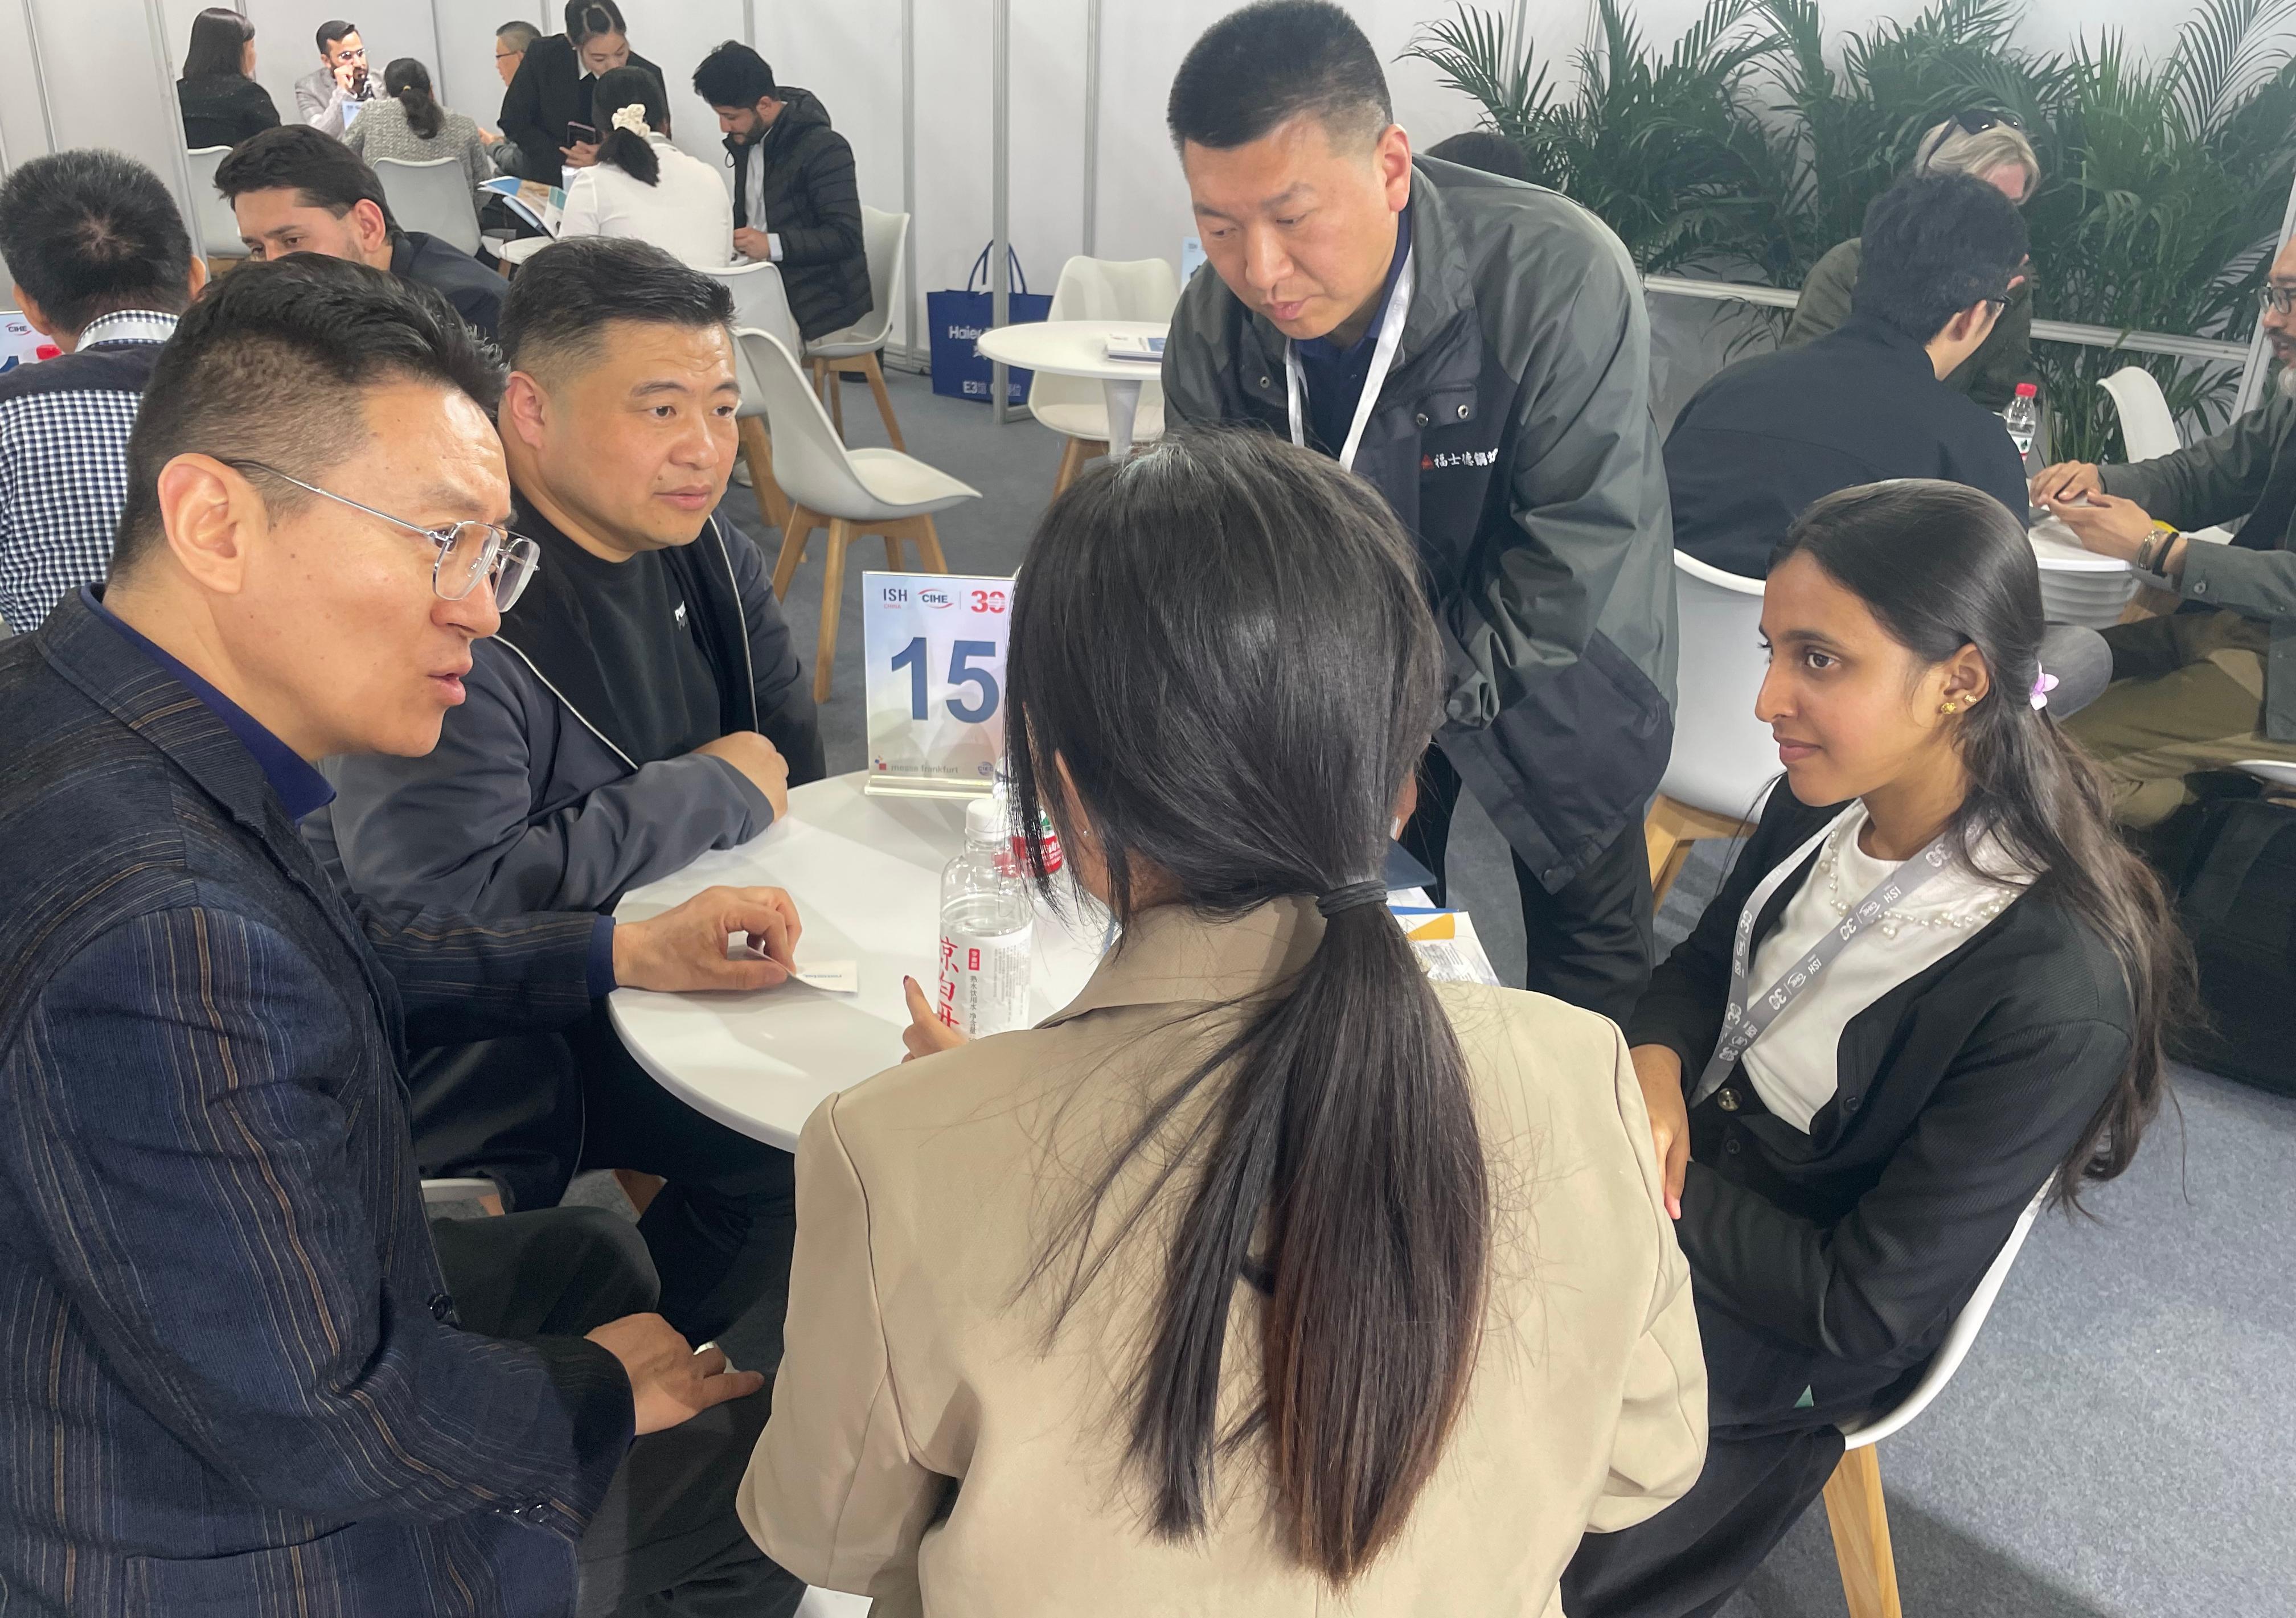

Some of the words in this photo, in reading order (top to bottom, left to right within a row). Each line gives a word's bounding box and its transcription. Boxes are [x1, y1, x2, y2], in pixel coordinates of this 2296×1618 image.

[949, 325, 982, 339] Haier
[883, 588, 907, 601] ISH
[922, 594, 948, 603] CIHE
[971, 590, 1005, 613] 30
[891, 636, 999, 724] 15
[1883, 885, 1902, 904] ISH
[1807, 957, 1822, 975] ISH
